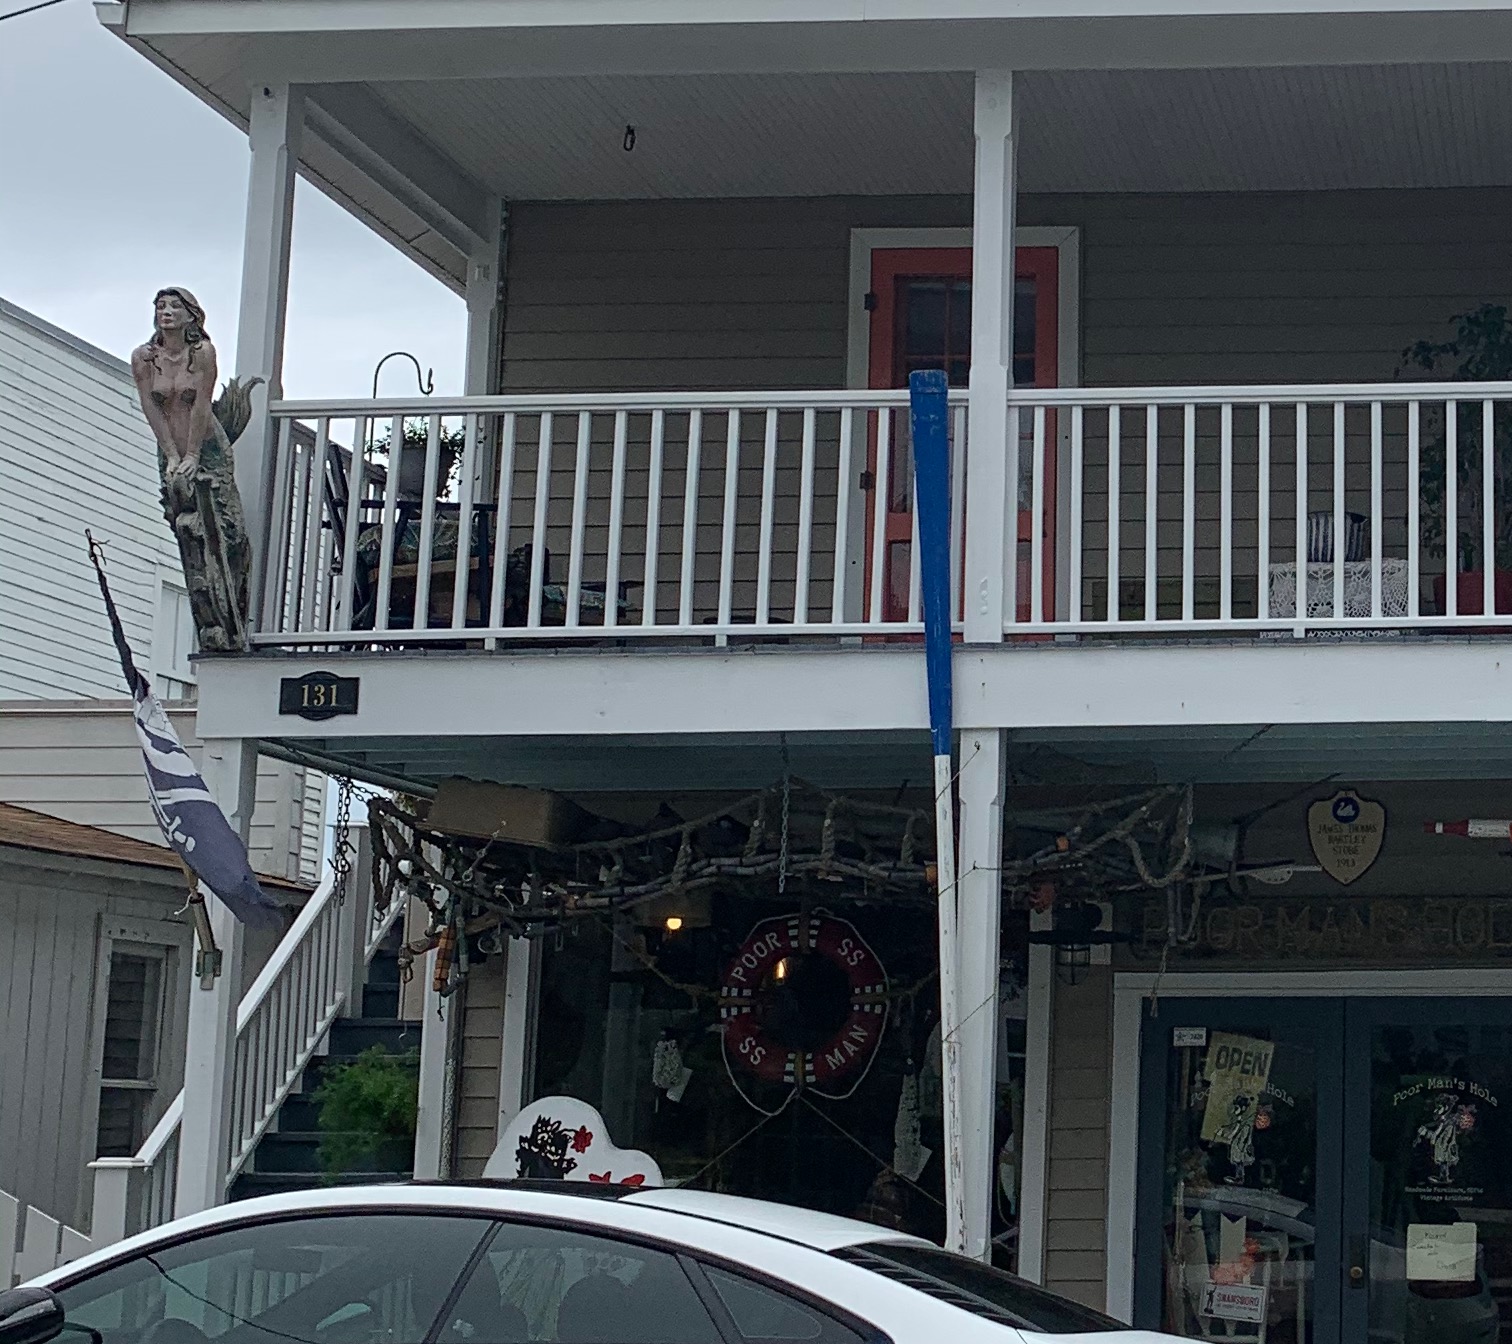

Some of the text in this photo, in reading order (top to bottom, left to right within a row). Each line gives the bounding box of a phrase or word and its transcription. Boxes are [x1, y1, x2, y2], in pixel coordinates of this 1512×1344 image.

[302, 684, 338, 707] 131
[731, 931, 782, 982] POOR
[837, 938, 865, 966] SS
[739, 1036, 767, 1065] SS
[825, 1024, 869, 1071] MAN
[1214, 1044, 1271, 1078] OPEN
[1266, 1082, 1295, 1108] Hole
[1393, 1077, 1498, 1108] Poor Man's Hole
